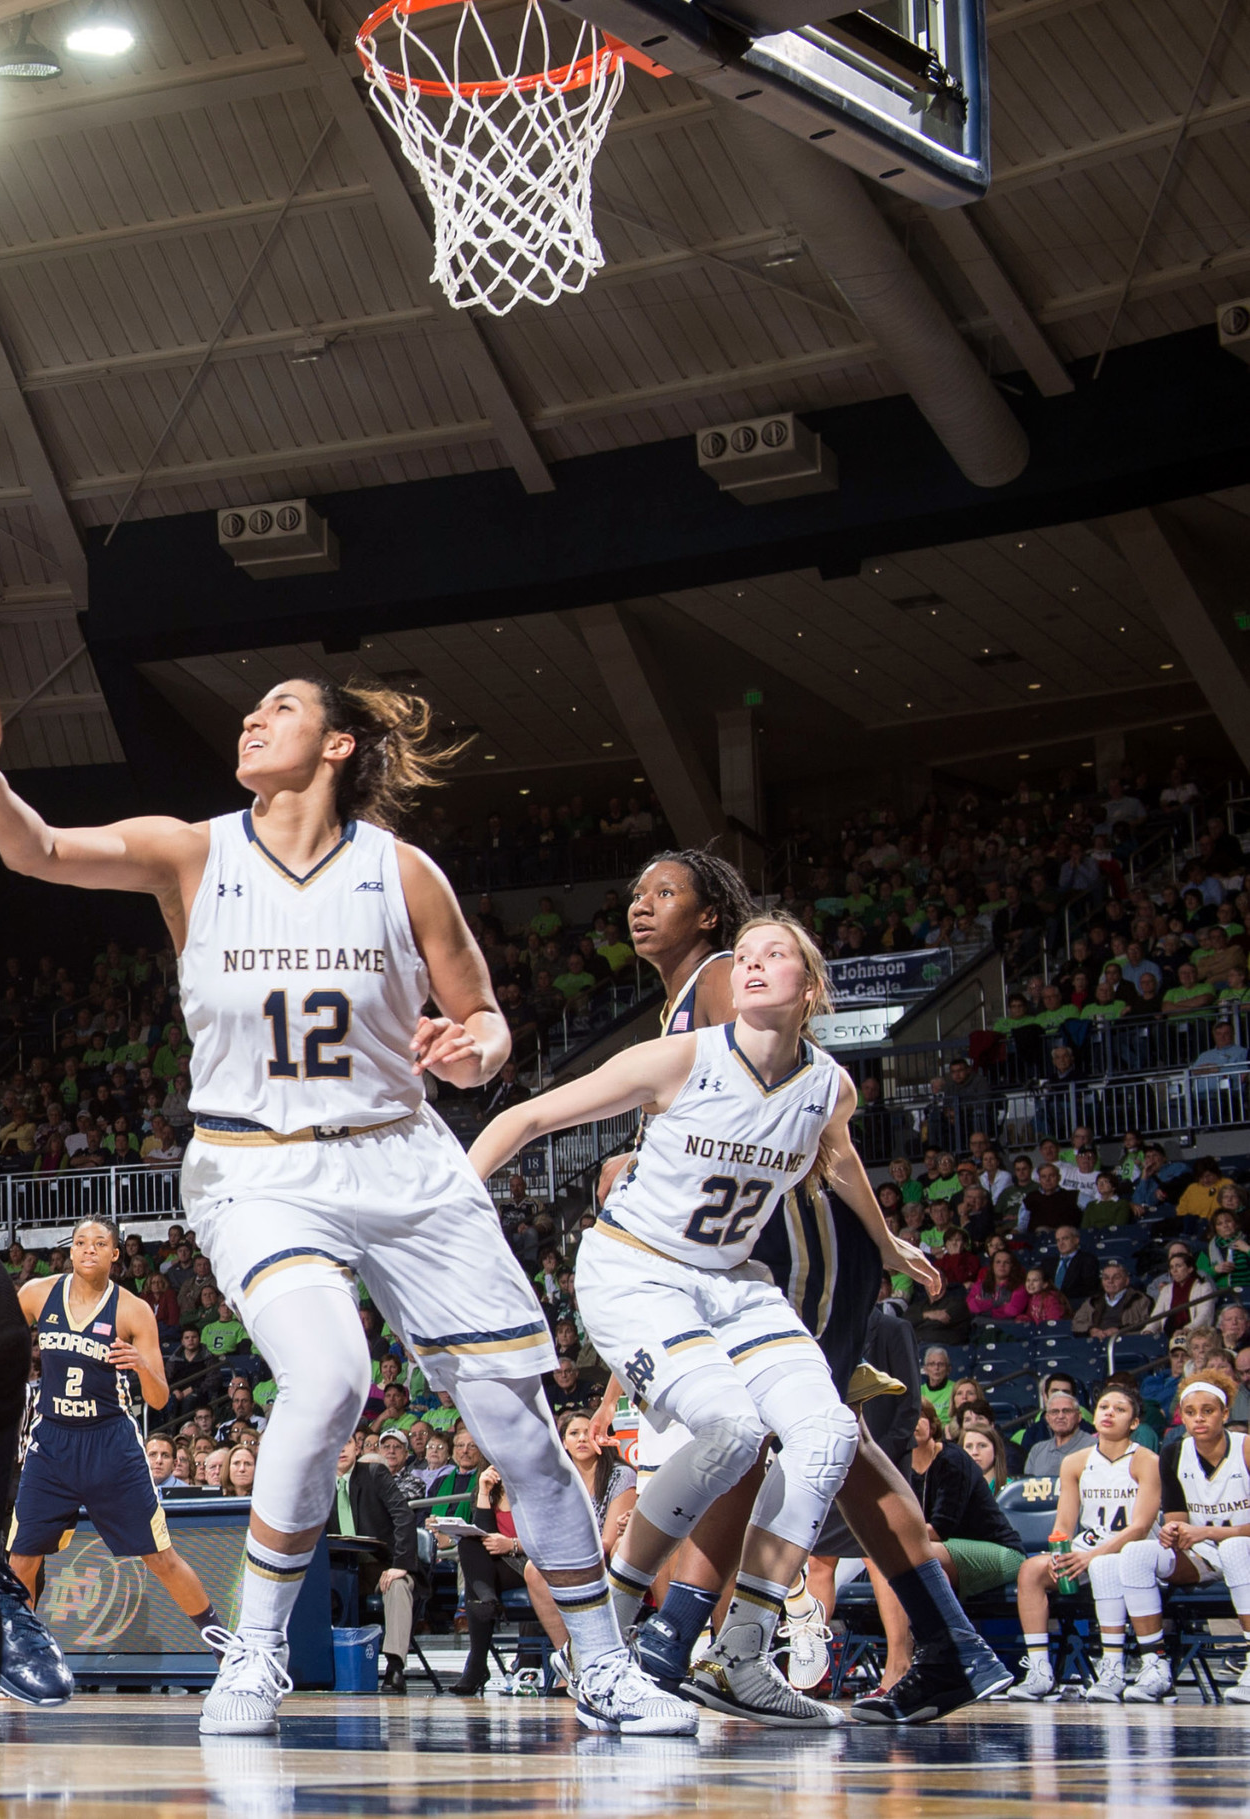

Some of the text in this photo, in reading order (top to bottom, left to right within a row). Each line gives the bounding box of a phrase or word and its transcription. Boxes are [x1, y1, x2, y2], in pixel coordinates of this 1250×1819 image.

[352, 881, 384, 893] ACC
[223, 948, 386, 975] NOTRE DAME
[838, 961, 906, 981] Johnson
[854, 980, 901, 997] Cable
[263, 988, 353, 1081] 12
[802, 1103, 825, 1116] ACC
[684, 1134, 807, 1173] NOTRE DAME
[527, 1158, 540, 1170] 18
[682, 1174, 775, 1247] 22
[38, 1332, 111, 1363] GEORGIA
[213, 1336, 225, 1349] 6
[65, 1367, 84, 1397] 2
[52, 1397, 97, 1417] TECH
[1082, 1488, 1112, 1499] NOTRE
[1187, 1498, 1250, 1515] NOTRE DAME
[1097, 1505, 1129, 1532] 14
